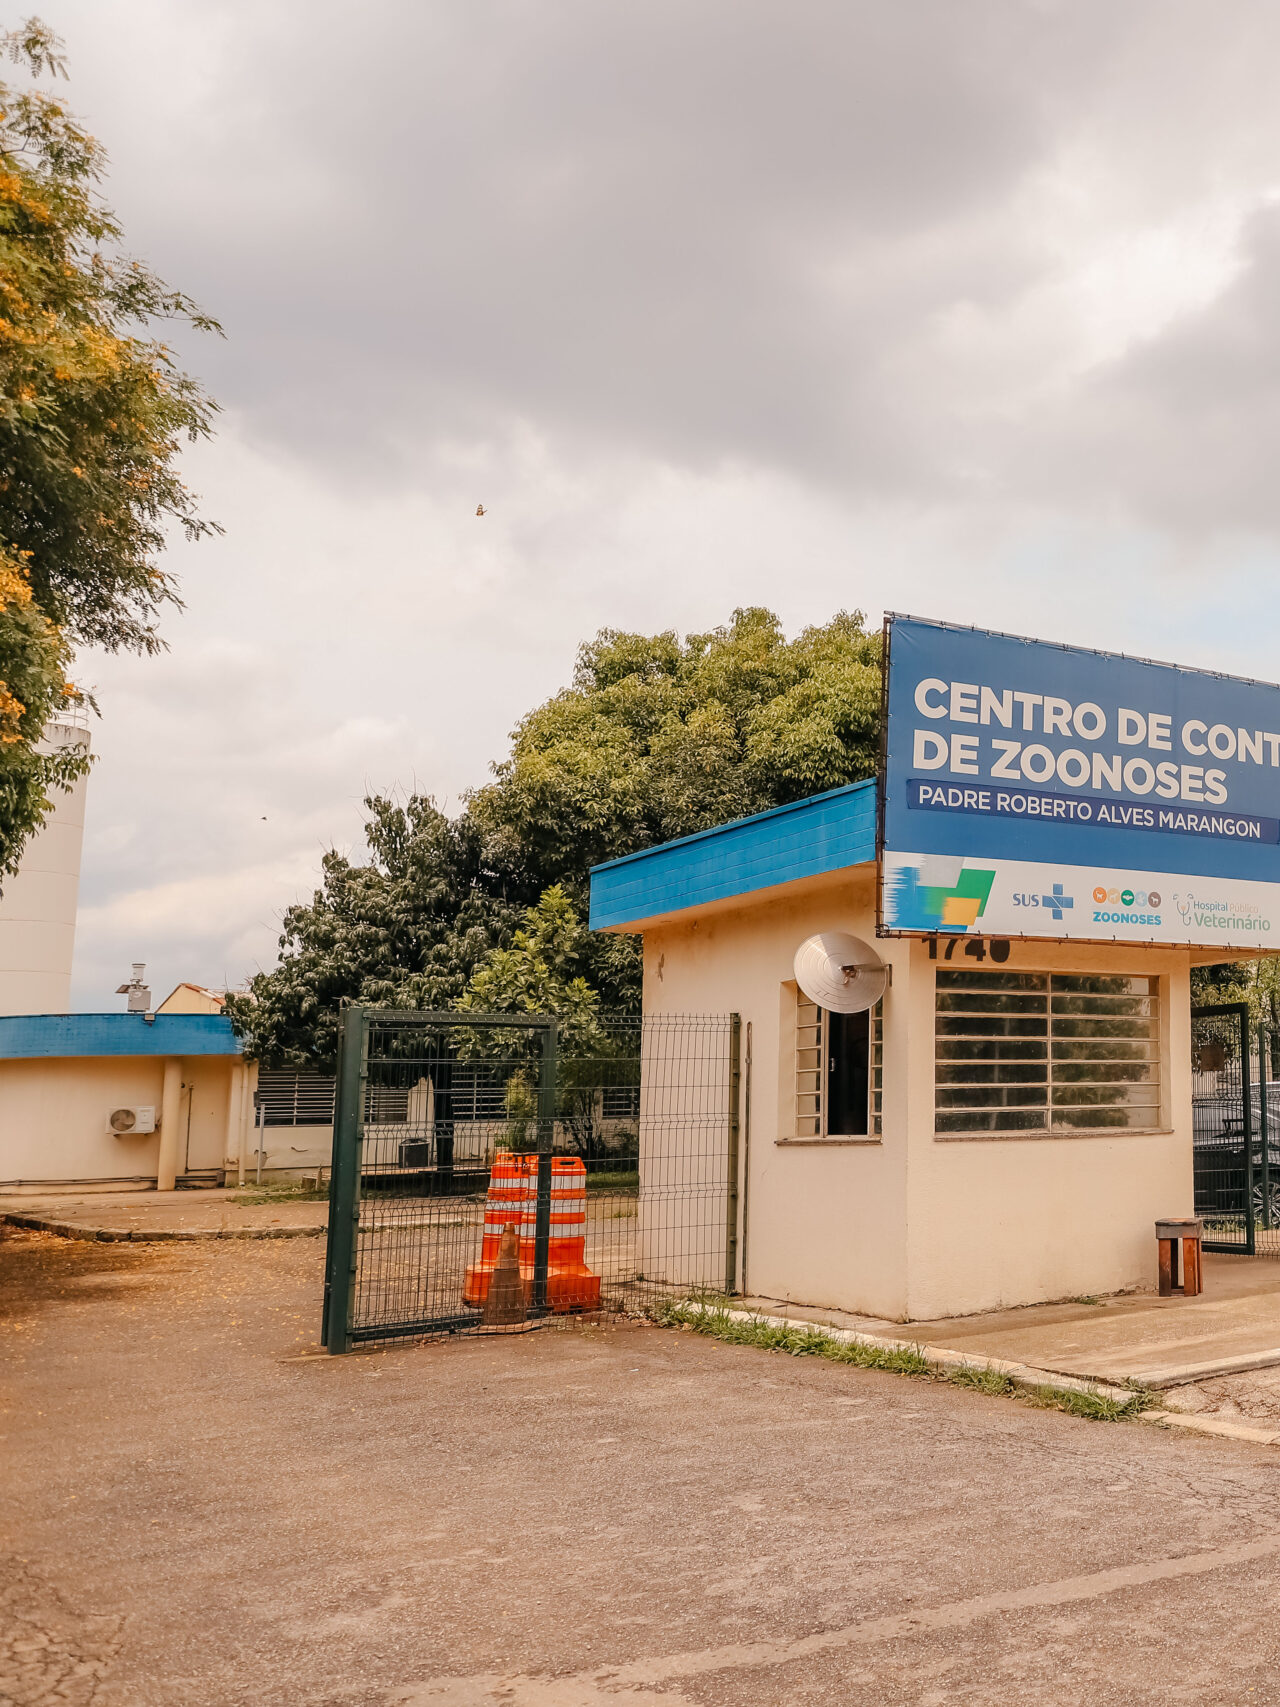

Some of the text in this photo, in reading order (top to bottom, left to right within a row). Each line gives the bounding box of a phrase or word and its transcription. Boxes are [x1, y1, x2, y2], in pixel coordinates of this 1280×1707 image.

[914, 678, 1105, 740] CENTRO
[1117, 708, 1172, 751] DE
[913, 729, 1228, 805] DE ZOONOSES
[918, 786, 1261, 839] PADRE ROBERTO ALVES MARANGON
[1012, 893, 1040, 908] SUS
[1193, 900, 1228, 912] Hospital
[1092, 911, 1162, 926] ZOONOSES
[1194, 912, 1271, 931] Veterinário
